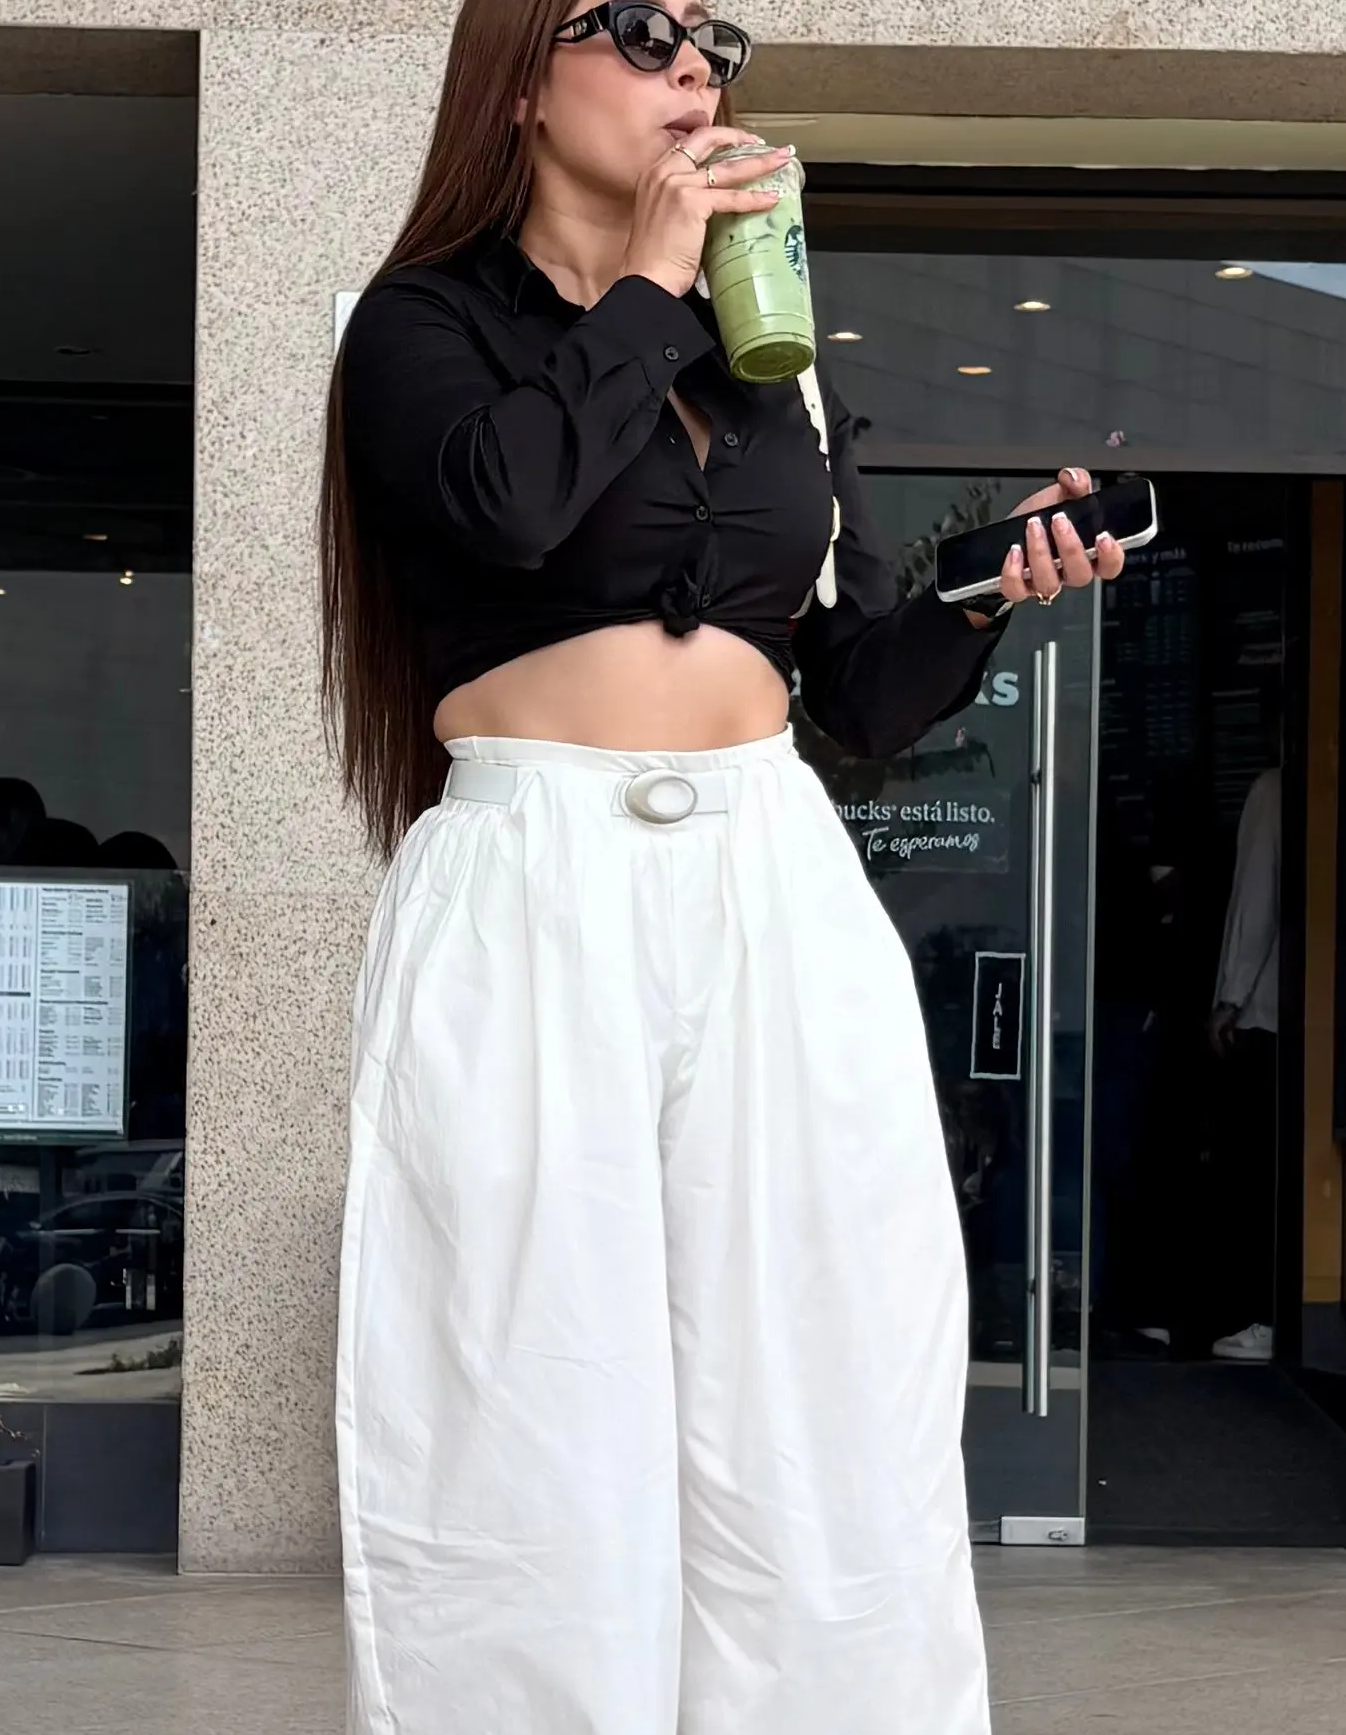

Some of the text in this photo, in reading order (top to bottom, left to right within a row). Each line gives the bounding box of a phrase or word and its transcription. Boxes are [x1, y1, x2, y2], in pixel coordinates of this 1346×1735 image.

[900, 801, 943, 821] está
[946, 802, 996, 823] listo.
[862, 826, 981, 862] Te esperamos
